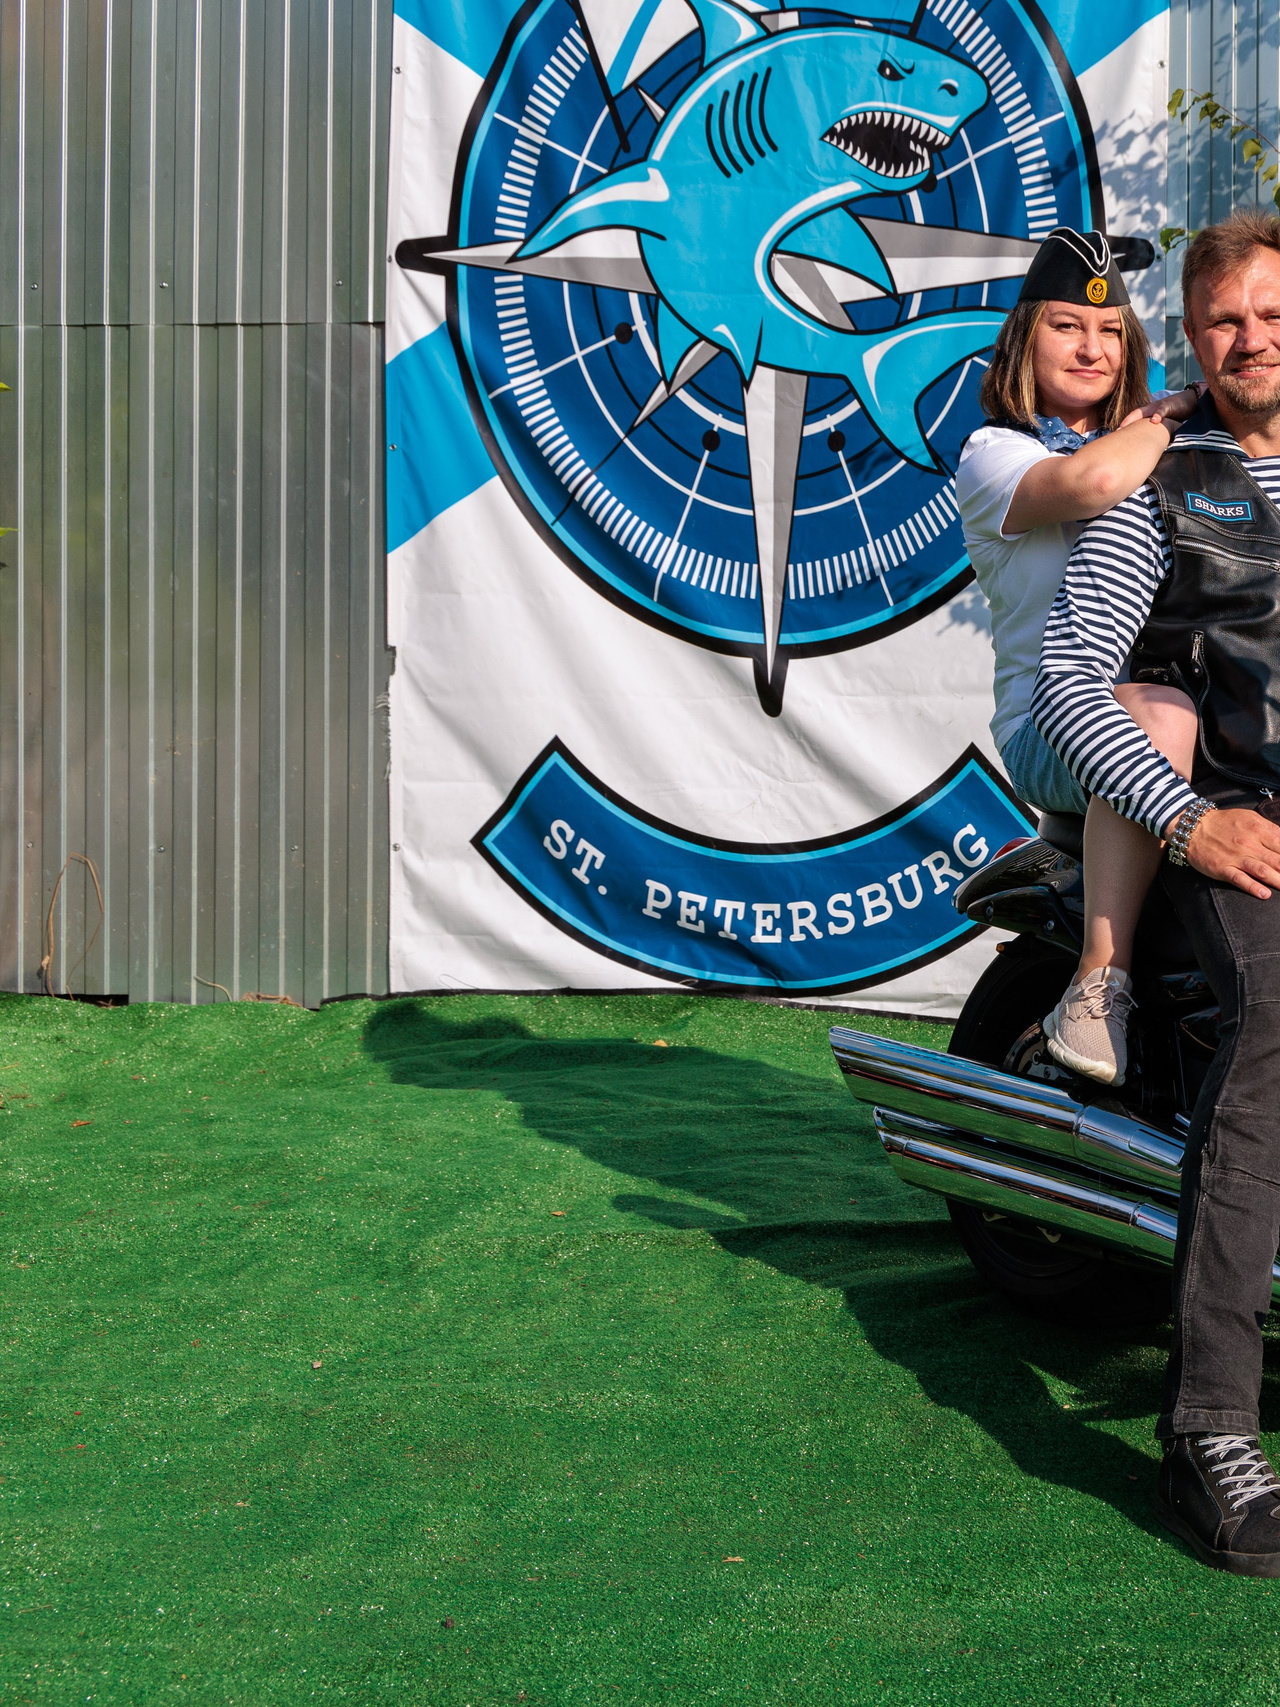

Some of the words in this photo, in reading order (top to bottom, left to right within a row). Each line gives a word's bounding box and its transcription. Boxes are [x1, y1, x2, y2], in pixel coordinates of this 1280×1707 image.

[1194, 498, 1244, 517] SHARKS
[543, 819, 608, 895] ST.
[642, 824, 990, 943] PETERSBURG
